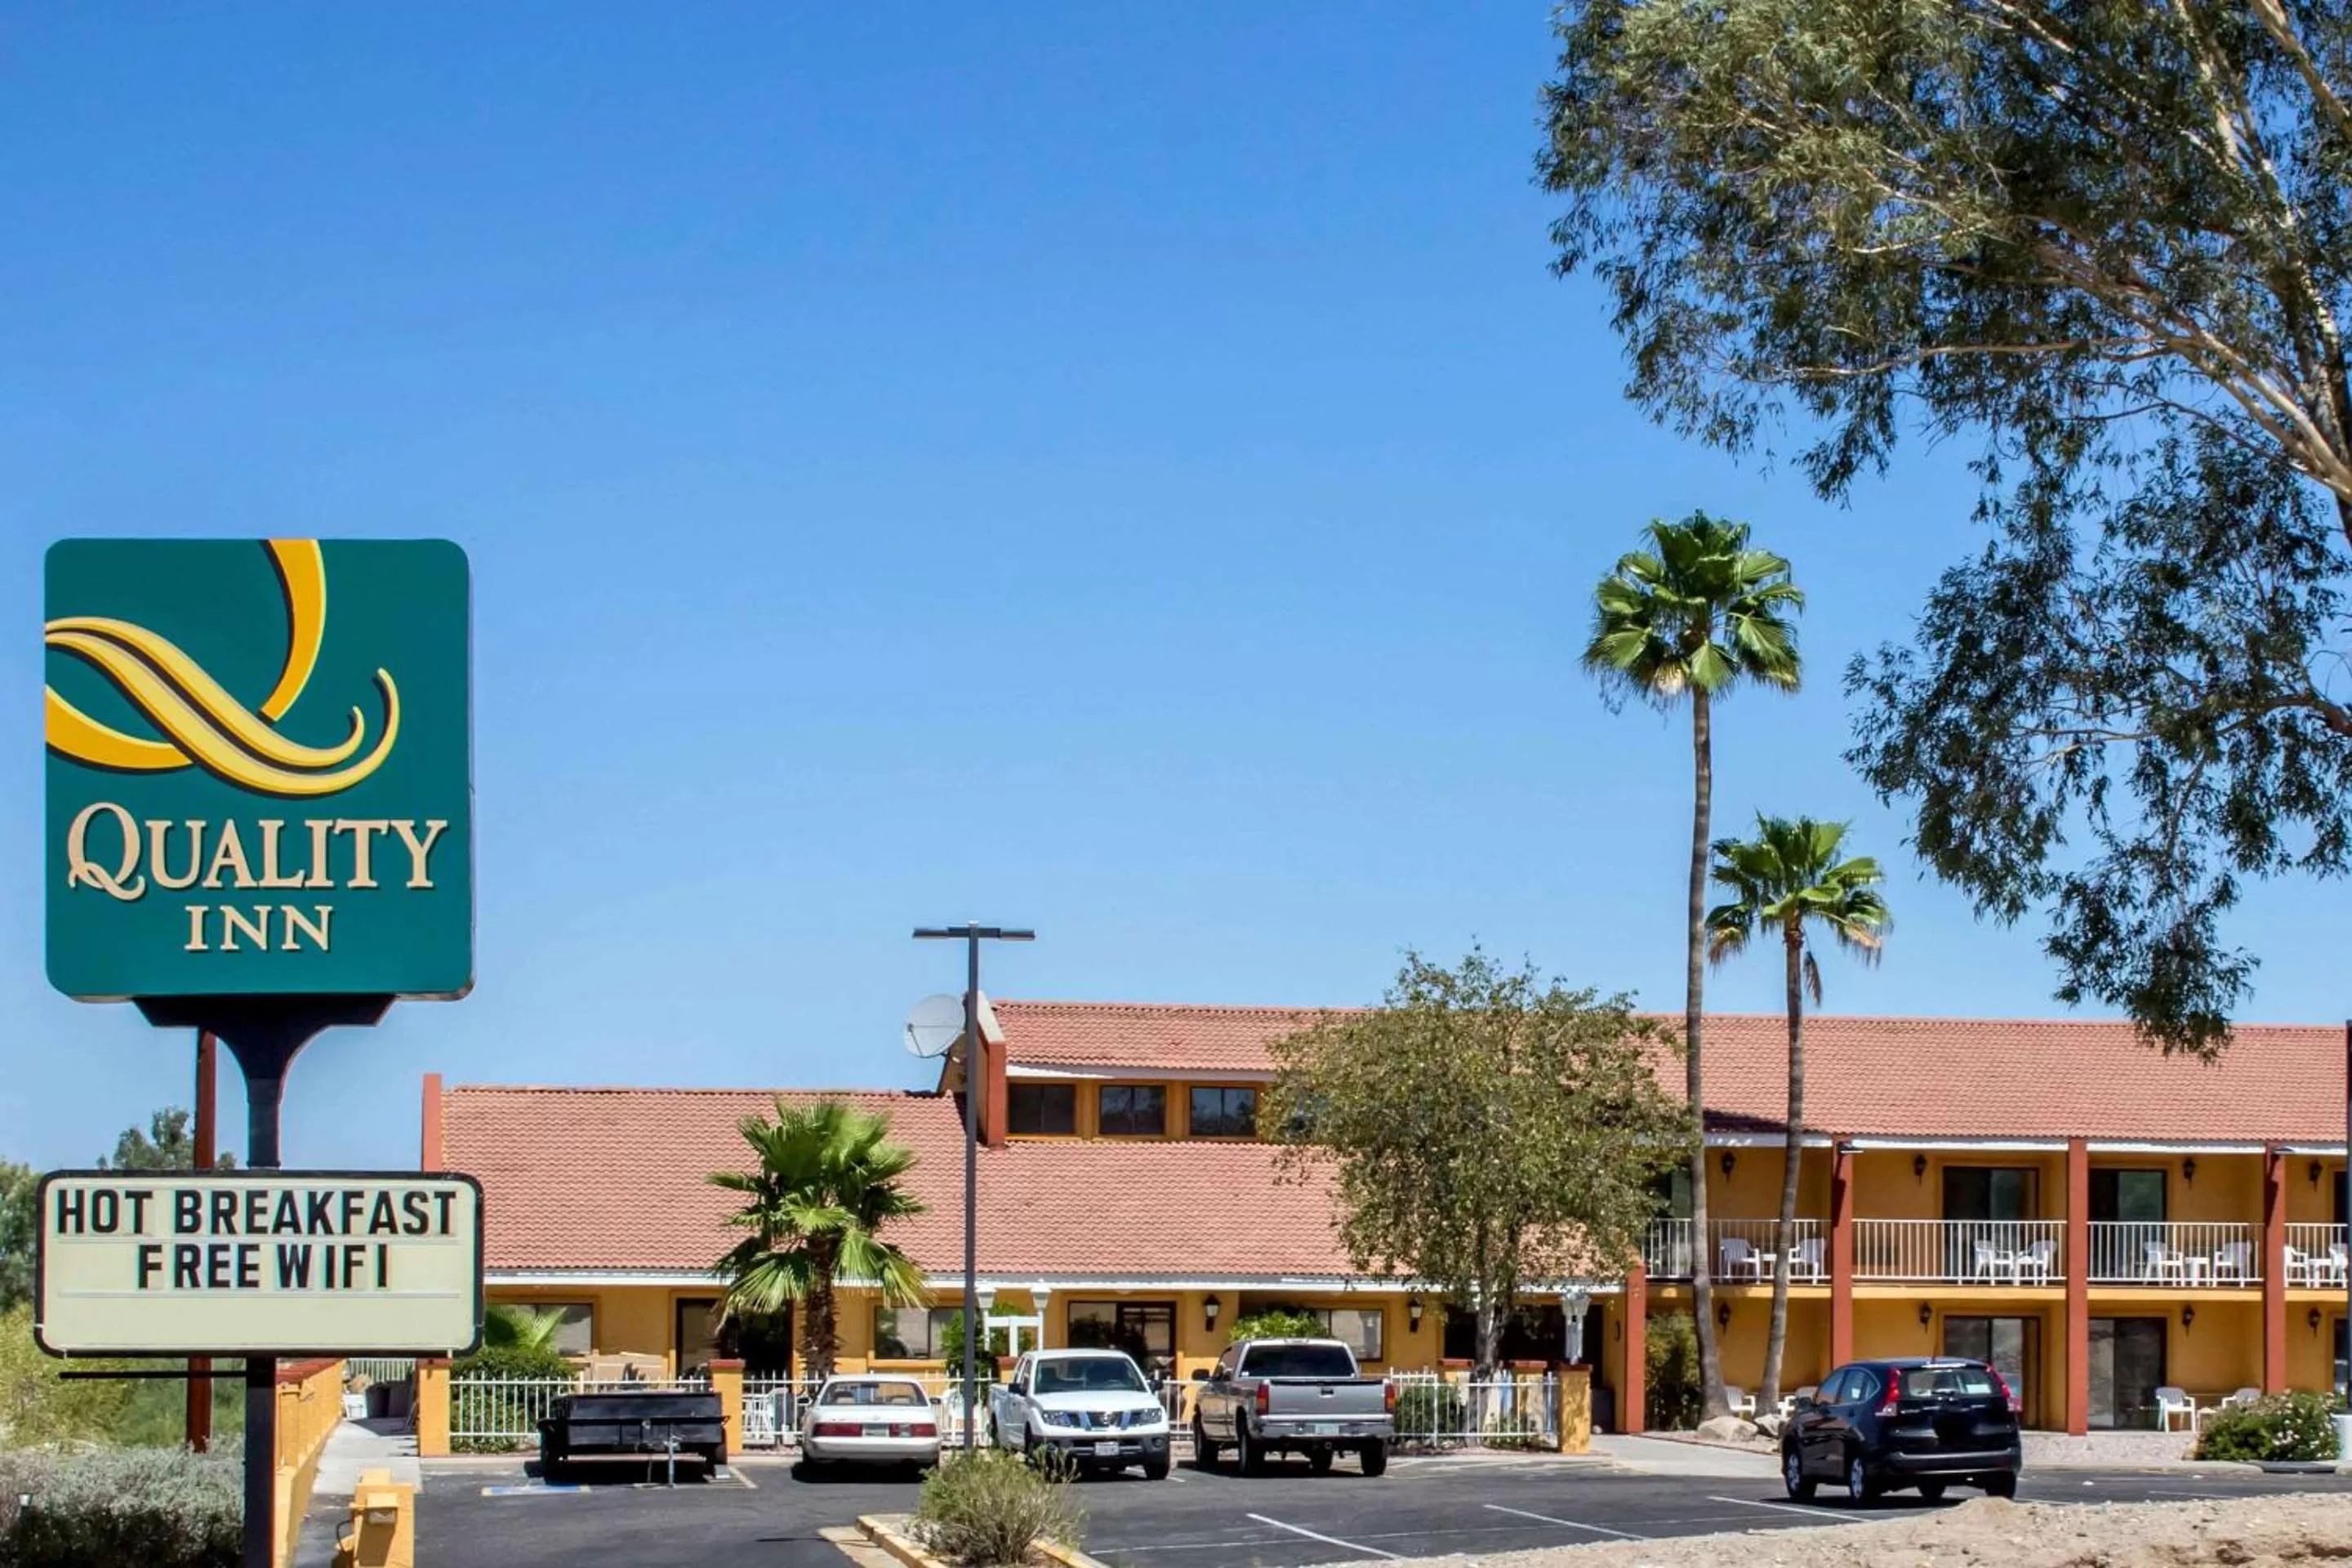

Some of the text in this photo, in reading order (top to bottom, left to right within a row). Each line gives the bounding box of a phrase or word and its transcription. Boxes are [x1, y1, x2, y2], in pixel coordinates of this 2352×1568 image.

[68, 802, 448, 900] QUALITY
[184, 905, 334, 951] INN
[57, 1189, 457, 1235] HOT BREAKFAST
[138, 1244, 388, 1290] FREE WIFI
